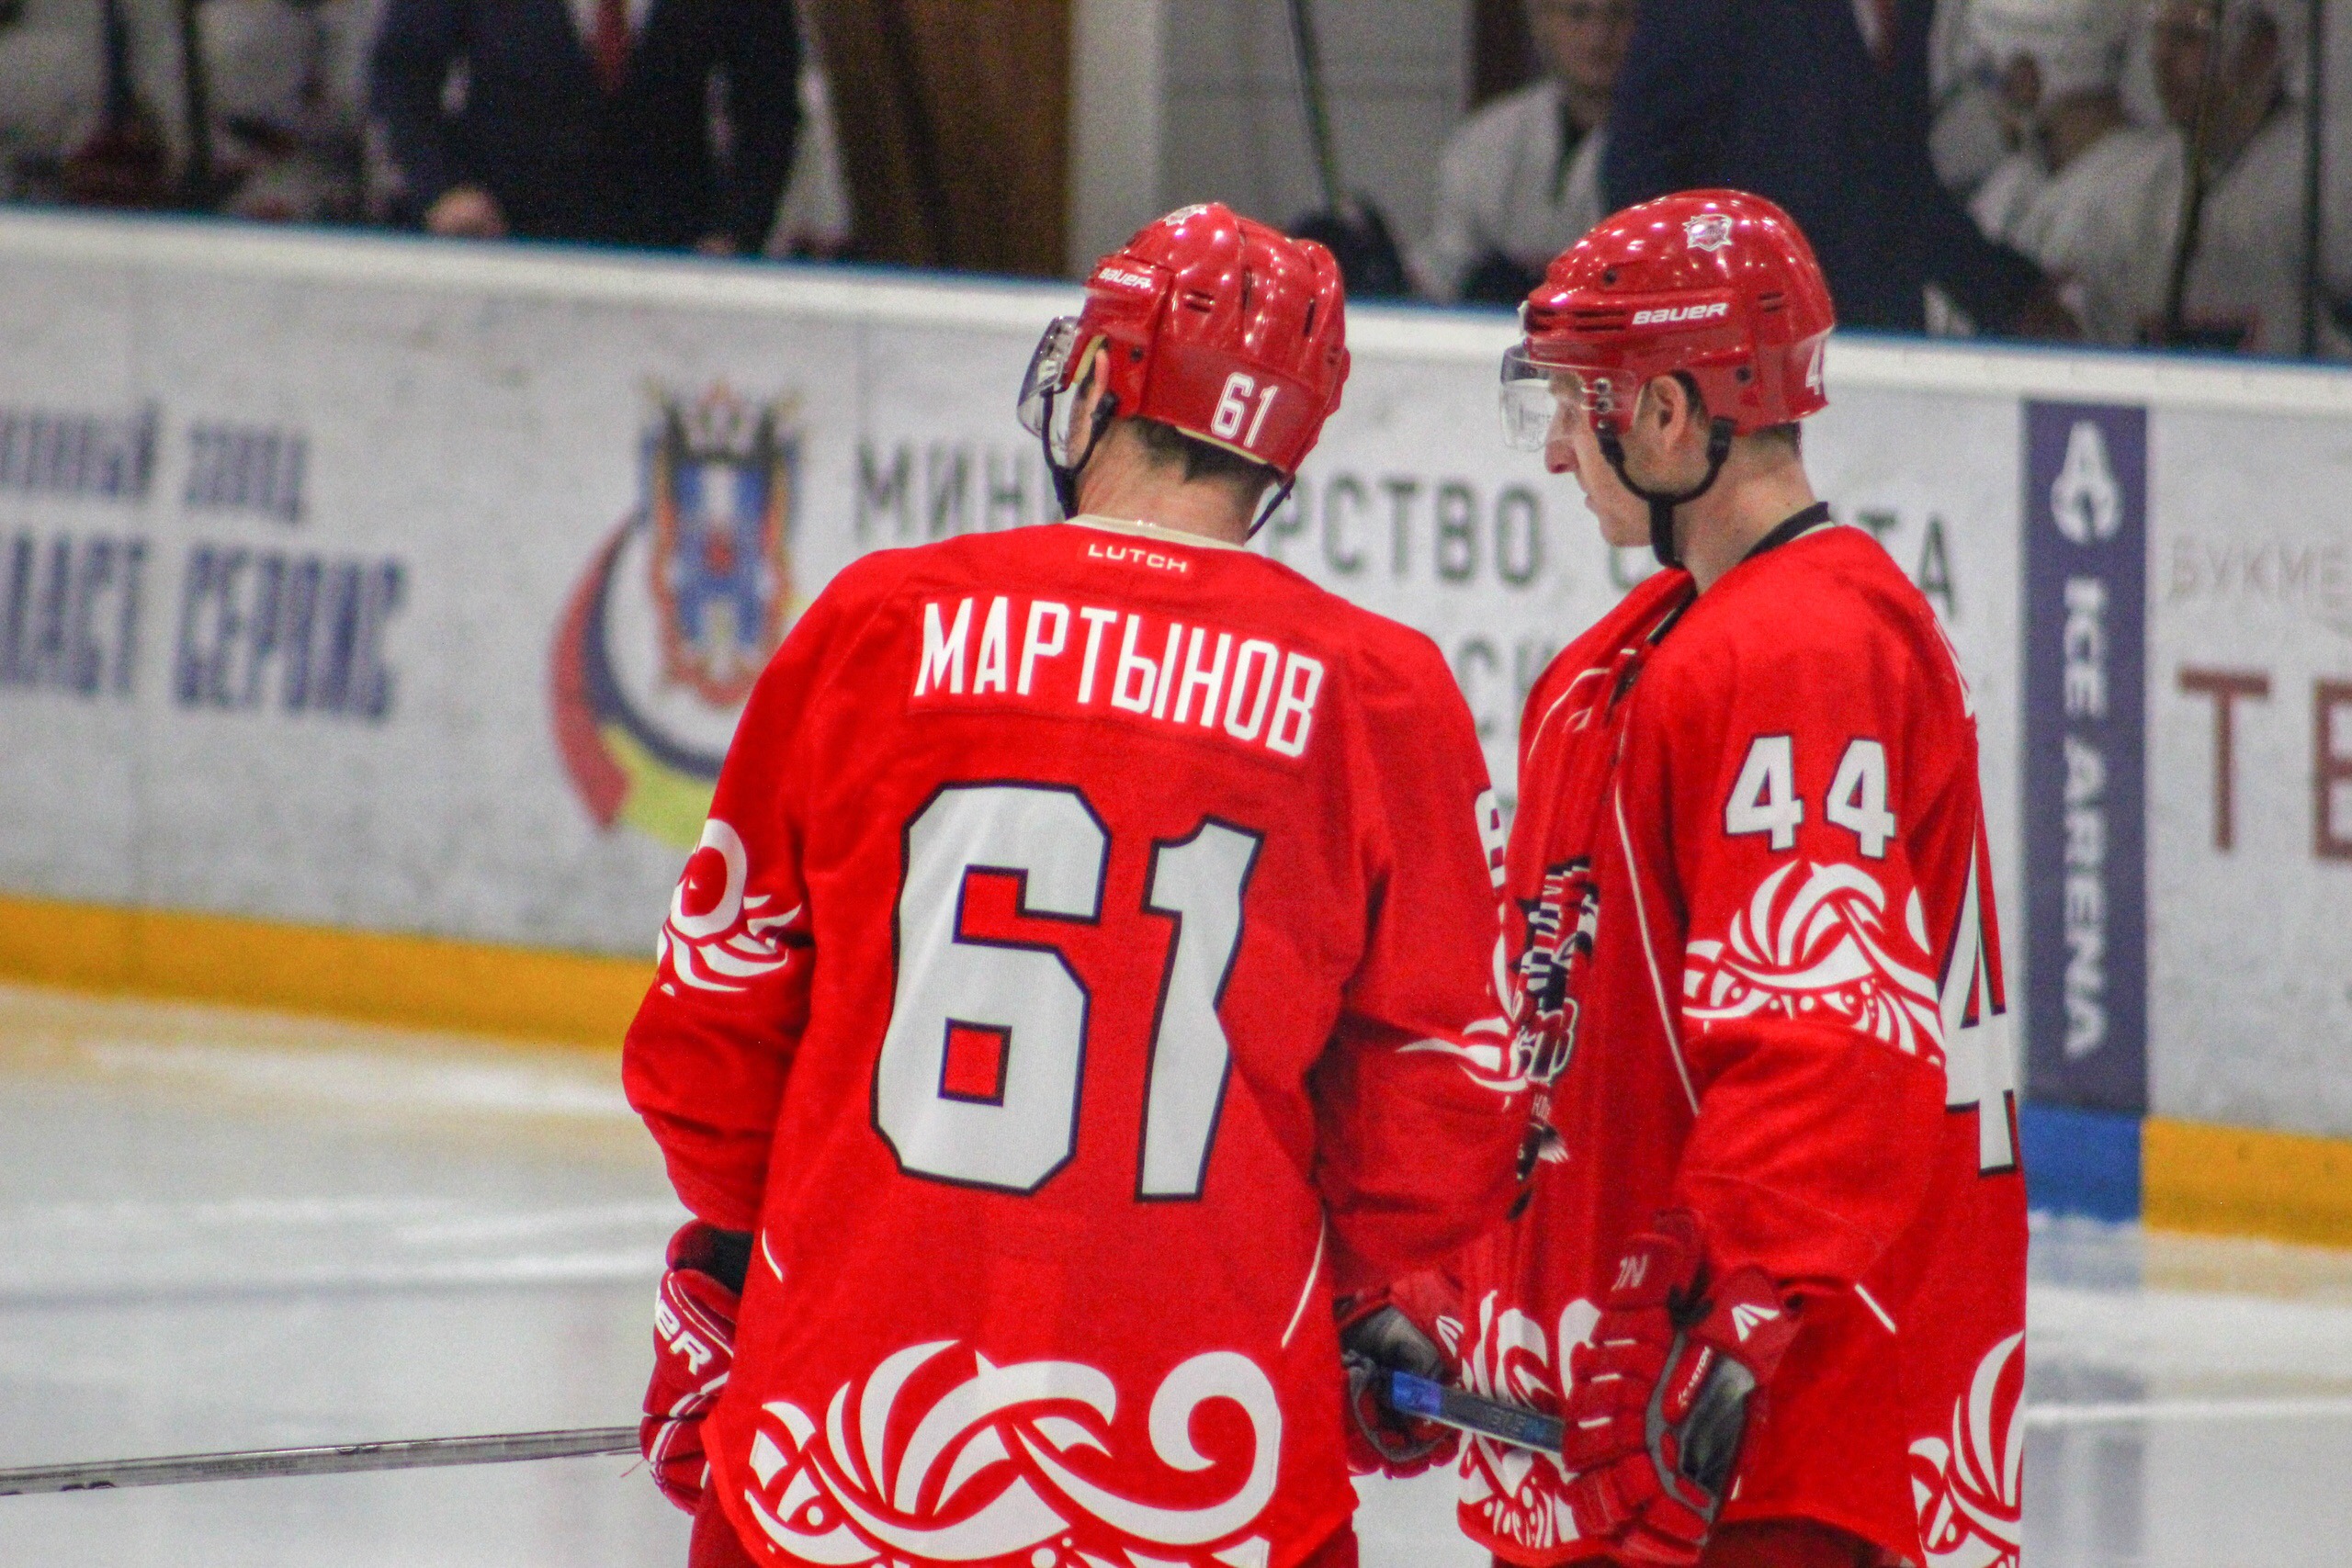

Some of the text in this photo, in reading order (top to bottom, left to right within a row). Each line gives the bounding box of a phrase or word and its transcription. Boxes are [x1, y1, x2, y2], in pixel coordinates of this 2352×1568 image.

[1098, 267, 1155, 289] BAUER
[1632, 301, 1729, 326] BAUER
[1209, 371, 1280, 448] 61
[1087, 543, 1189, 574] LUTCH
[913, 596, 1325, 758] МАРТЫНОВ
[1722, 732, 1897, 861] 44
[2064, 576, 2110, 1064] ICE ARENA
[869, 778, 1264, 1202] 61
